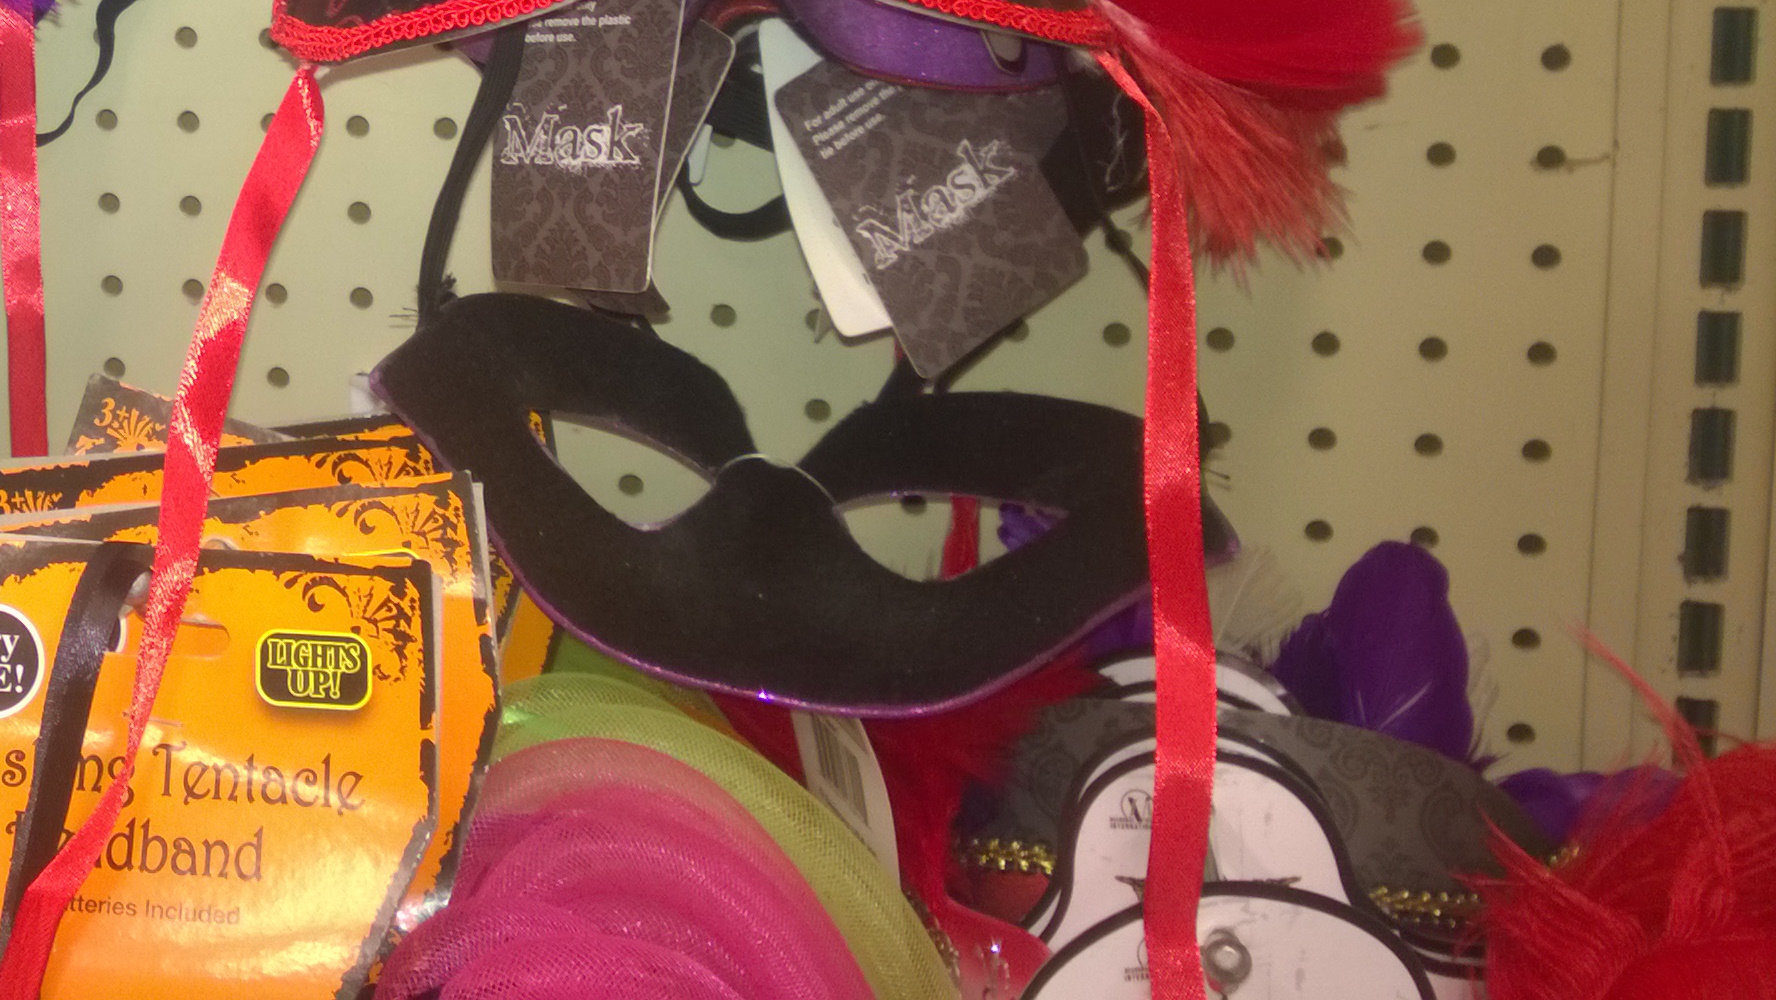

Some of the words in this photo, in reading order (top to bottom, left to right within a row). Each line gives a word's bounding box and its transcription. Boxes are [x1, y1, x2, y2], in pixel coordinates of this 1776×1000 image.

[545, 17, 579, 28] remove
[581, 14, 597, 27] the
[598, 13, 631, 29] plastic
[556, 32, 576, 43] use.
[804, 115, 822, 131] For
[824, 98, 848, 119] adult
[847, 87, 865, 103] use
[812, 121, 845, 146] Please
[845, 97, 879, 123] remove
[879, 85, 896, 100] the
[500, 103, 645, 168] Mask
[833, 127, 865, 150] before
[855, 138, 1017, 270] Mask
[94, 397, 129, 427] 3+
[266, 638, 362, 673] LIGHTS
[287, 667, 342, 699] UP!
[152, 741, 366, 816] Tentacle
[5, 809, 264, 881] dband
[64, 895, 138, 917] tteries
[145, 899, 241, 926] Included
